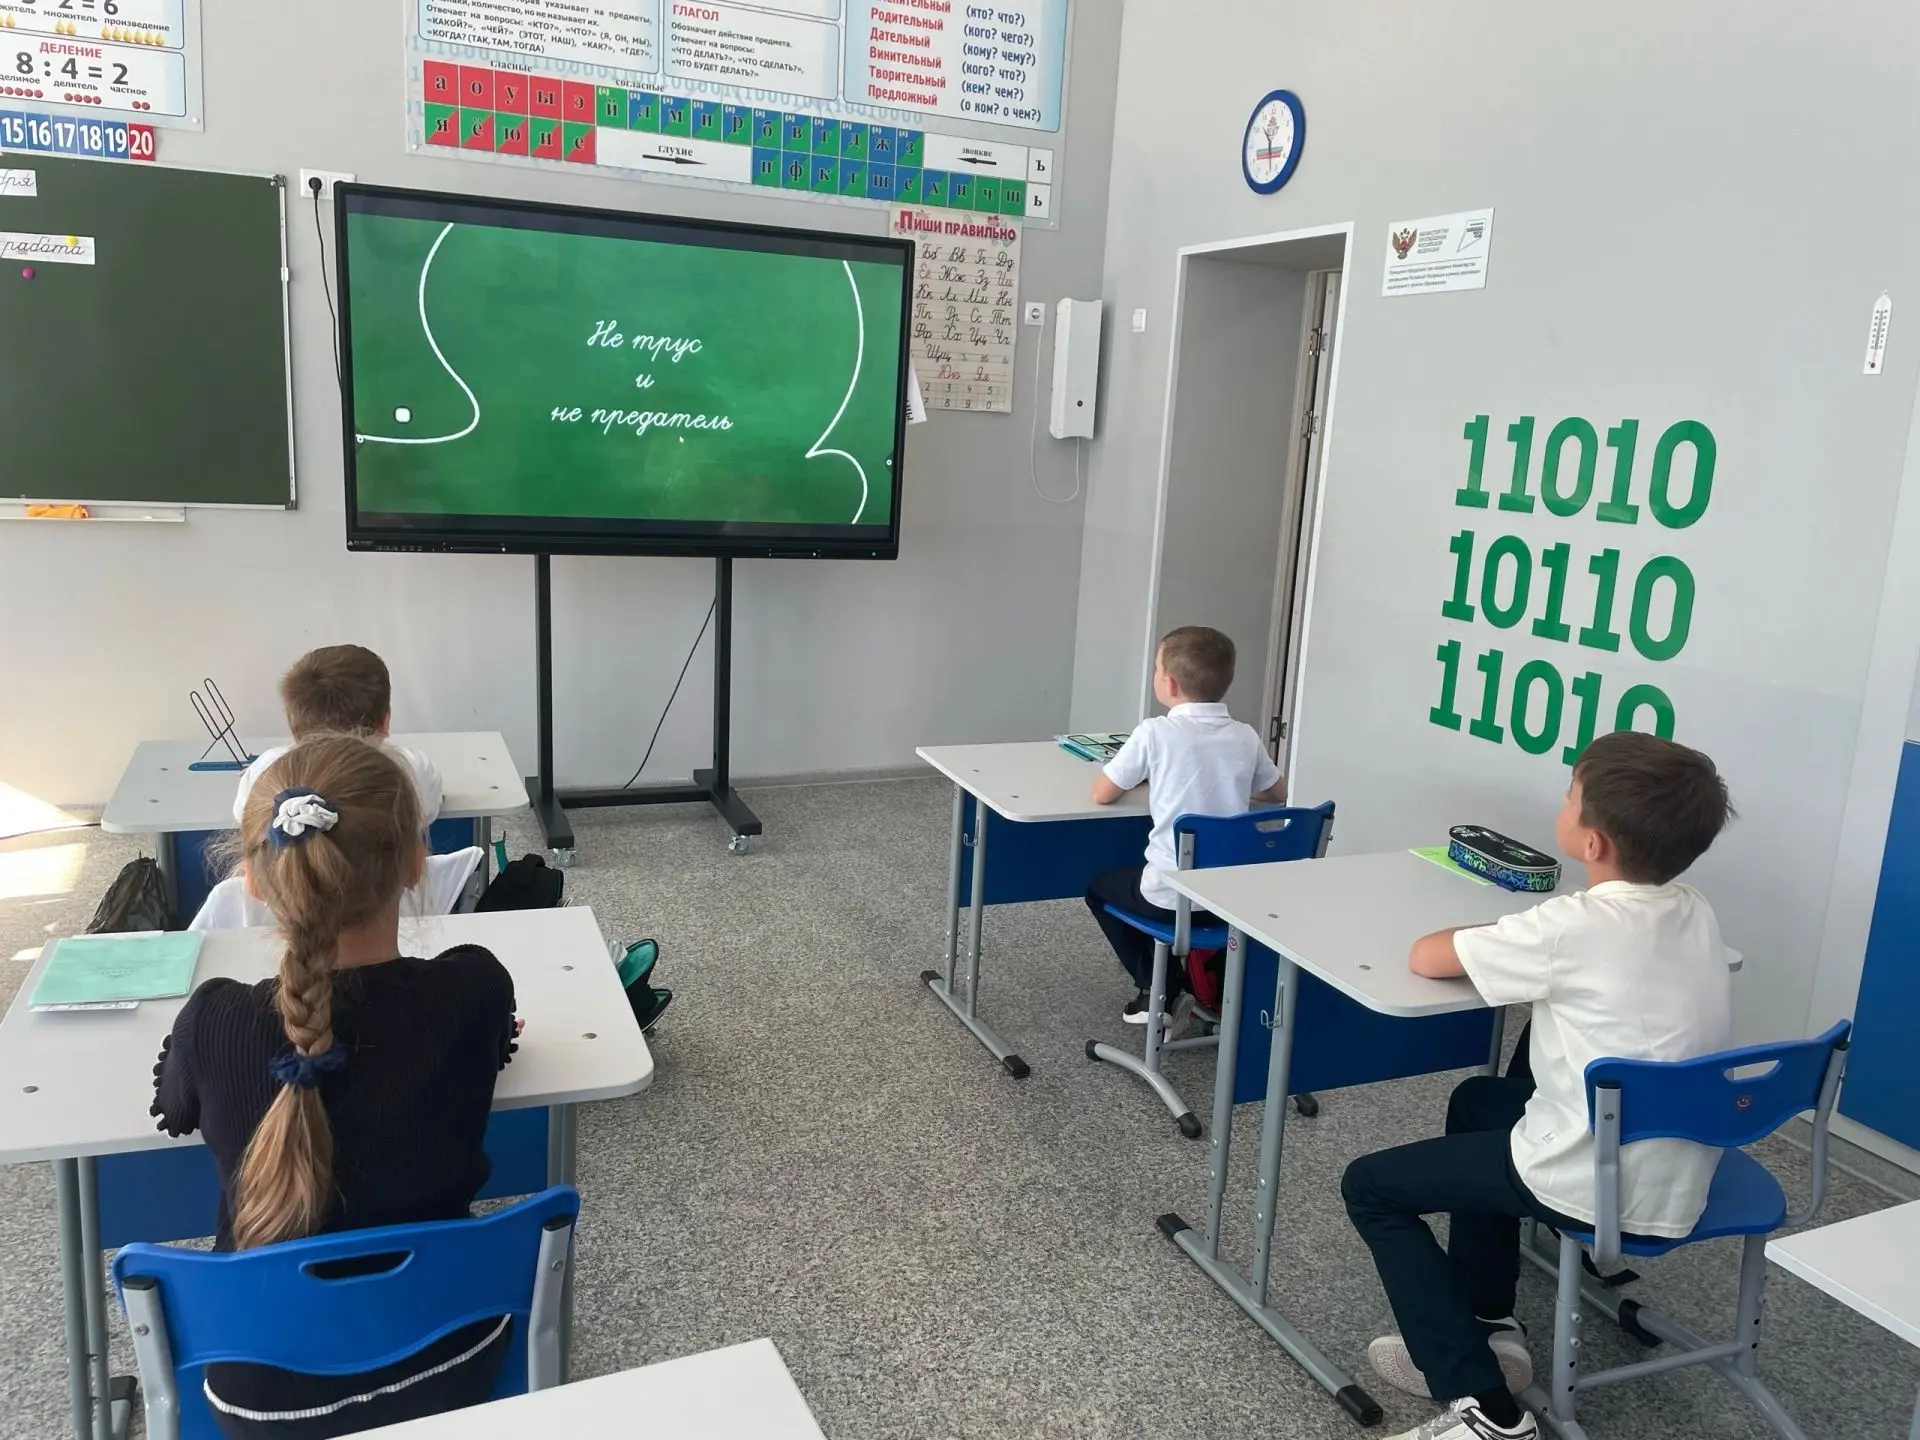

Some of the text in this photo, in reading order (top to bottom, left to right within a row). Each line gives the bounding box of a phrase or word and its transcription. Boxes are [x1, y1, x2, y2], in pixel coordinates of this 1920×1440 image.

[427, 5, 466, 16] Отвечает
[545, 0, 589, 13] указывает
[673, 5, 719, 22] ГЛАГОЛ
[966, 5, 1025, 27] (кто? что?)
[0, 5, 170, 31] житель множитель произведение
[871, 8, 1034, 47] Родительный (кого? чего?)
[671, 22, 716, 36] Обозначает
[718, 30, 753, 42] действие
[671, 34, 707, 46] Отвечает
[40, 42, 102, 58] ДЕЛЕНИЕ
[514, 42, 544, 54] ТОГДА)
[870, 27, 1036, 66] Дательный (кому? чему?)
[491, 61, 532, 72] гласные
[694, 62, 718, 72] БУДЕТ
[869, 47, 1026, 83] Винительный (кого? что?)
[54, 81, 98, 90] делитель
[110, 86, 146, 95] частное
[435, 76, 446, 90] а
[471, 81, 482, 95] о
[506, 86, 517, 104] у
[537, 91, 554, 104] ы
[616, 79, 665, 92] согласные
[869, 65, 1024, 101] Творительный (кем? чем?)
[868, 85, 1041, 122] Предложный (о ком? о чем?)
[1, 118, 153, 155] 15 16 17 18 19 20
[437, 119, 447, 131] я
[505, 128, 520, 141] ю
[658, 144, 693, 156] глухие
[790, 161, 802, 181] ф
[922, 244, 941, 259] Бб
[950, 247, 966, 262] Вв
[996, 251, 1014, 272] Дд
[916, 284, 933, 299] Кк
[996, 291, 1012, 306] Нн
[915, 303, 1012, 326] Пп Рр Сс Тт
[588, 321, 703, 362] Не трус
[636, 373, 654, 389] и
[550, 407, 734, 436] не предатель
[1455, 414, 1717, 529] 11010
[1442, 529, 1695, 661] 10110
